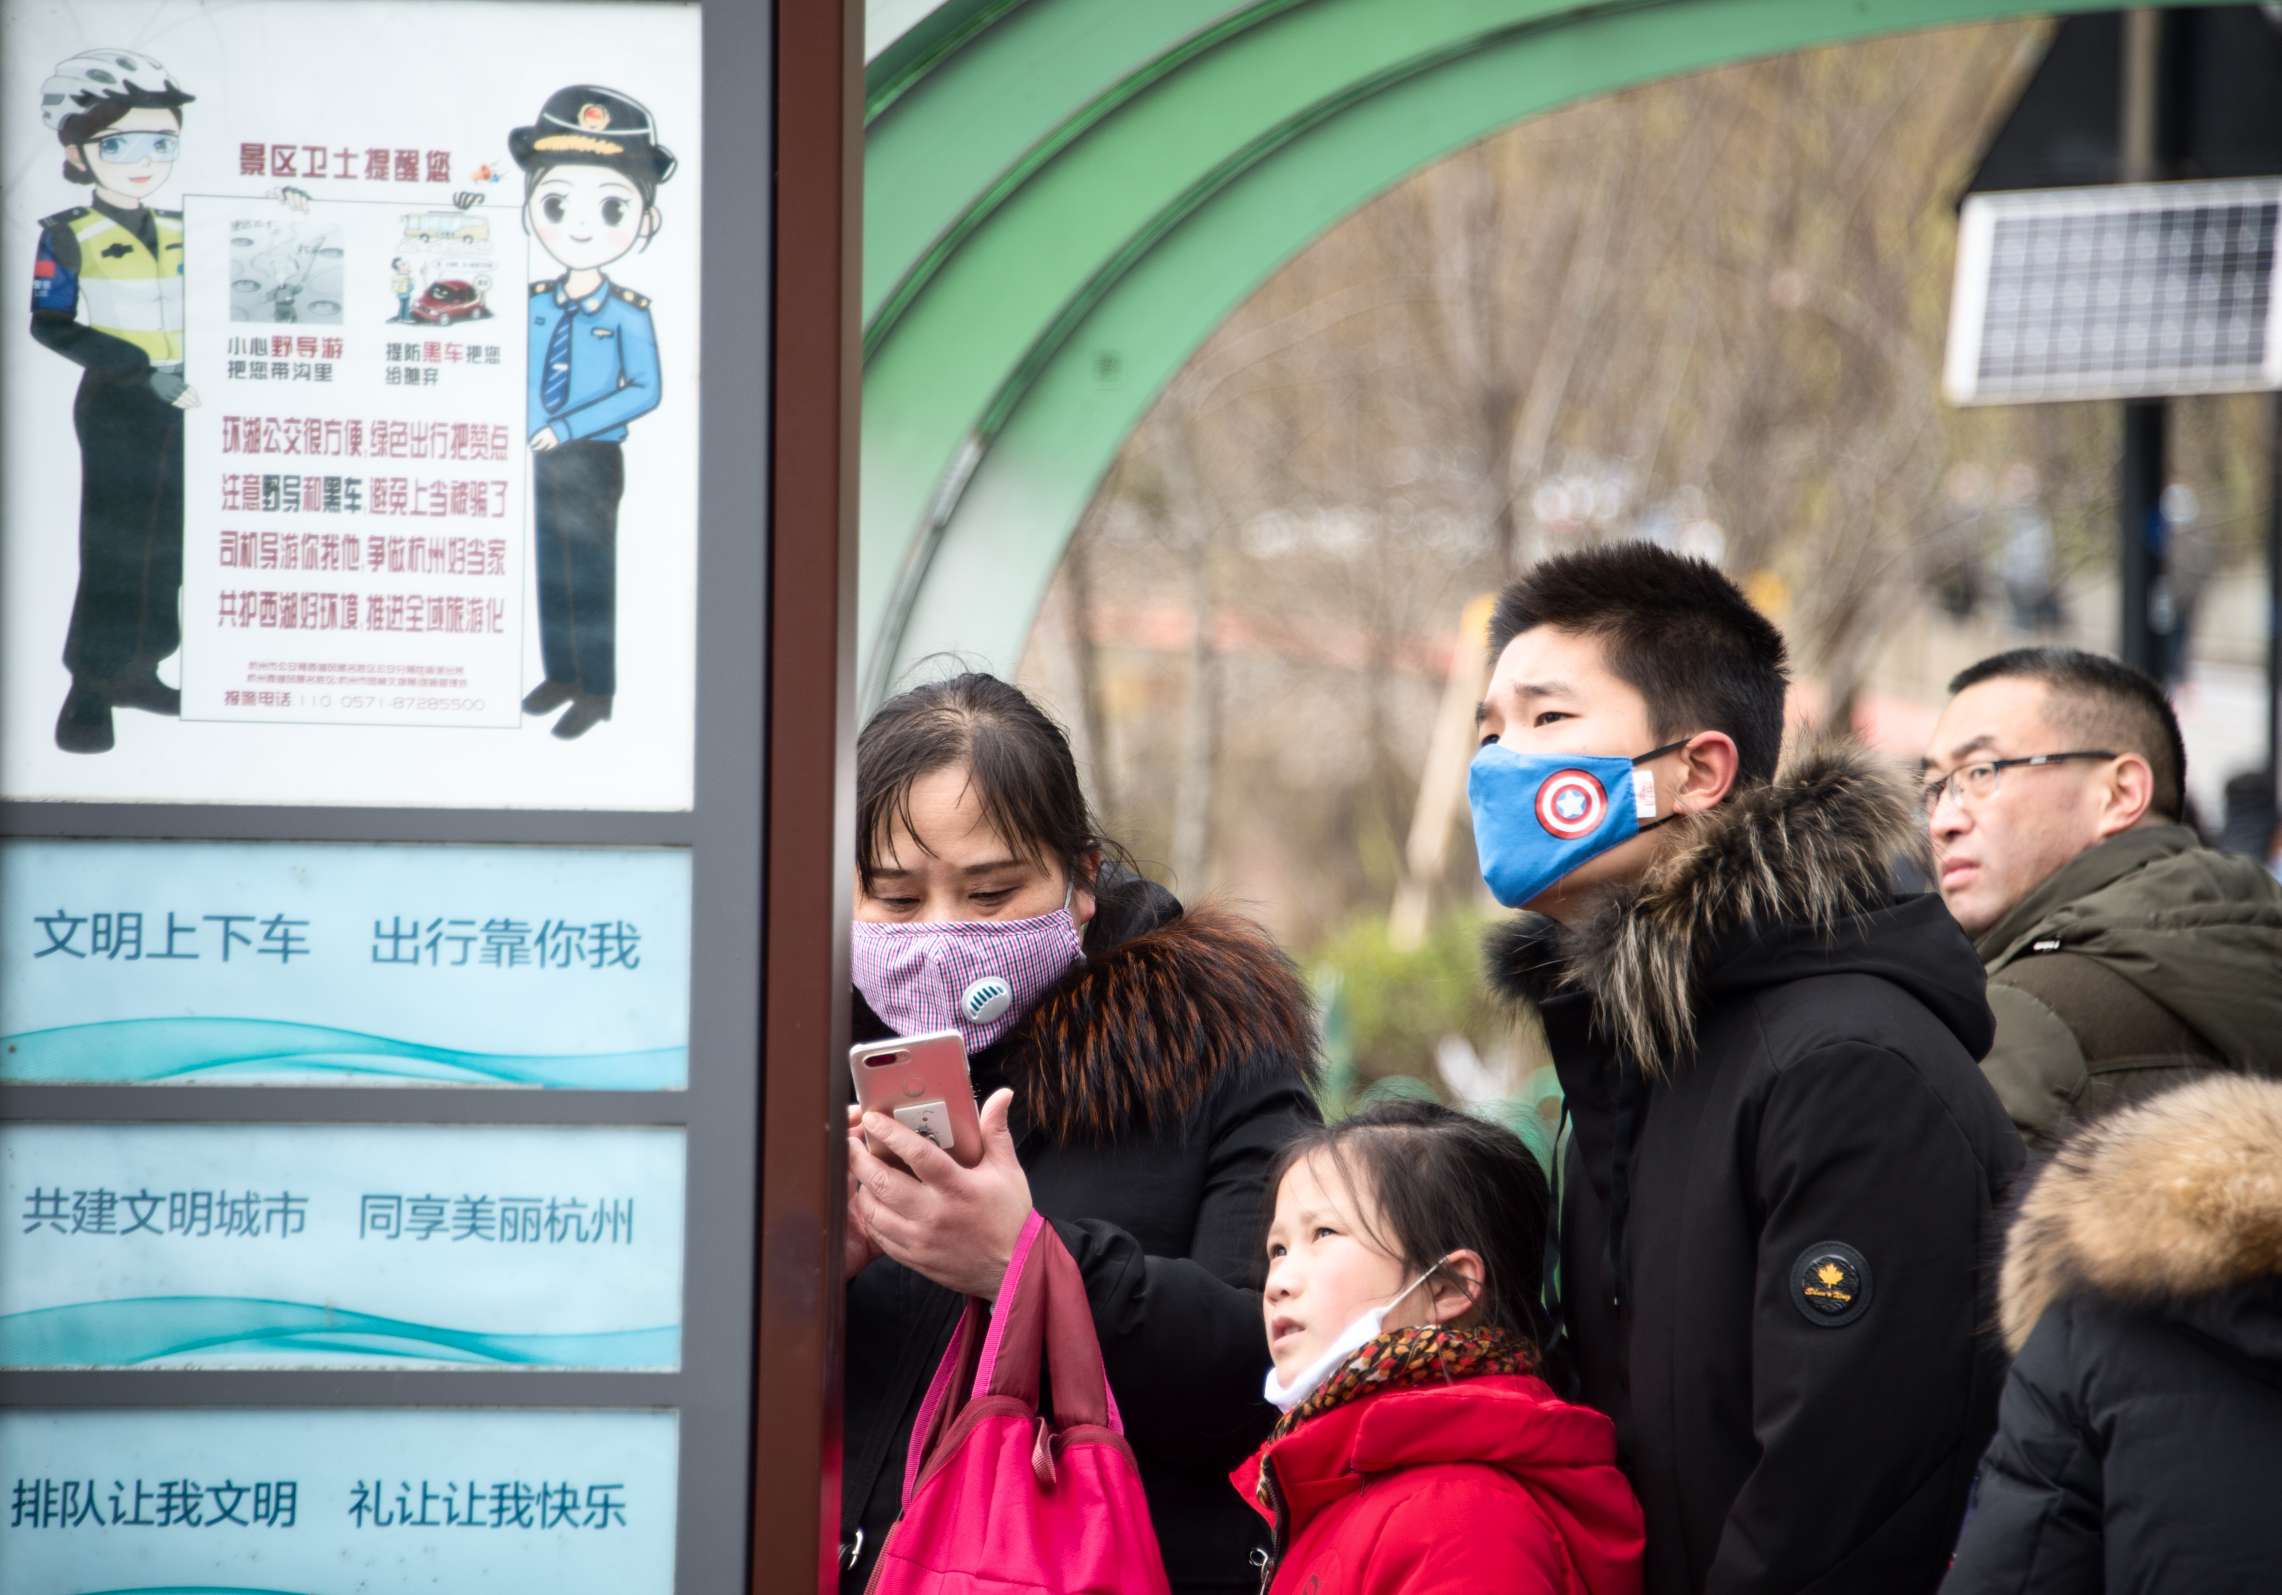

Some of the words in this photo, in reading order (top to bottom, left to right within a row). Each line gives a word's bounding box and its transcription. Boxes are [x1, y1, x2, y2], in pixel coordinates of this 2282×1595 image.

[239, 142, 451, 182] 景区卫士提醒您
[227, 335, 344, 359] 小心野导游
[385, 341, 501, 364] 提防黑车把您
[227, 360, 333, 382] 把您带沟里
[33, 909, 311, 965] 文明上下车
[371, 915, 642, 970] 出行靠你我
[22, 1186, 309, 1240] 共建文明城市
[359, 1192, 635, 1246] 同享美丽杭州
[10, 1478, 299, 1530] 排队让我文明
[347, 1479, 627, 1530] 礼让让我快乐
